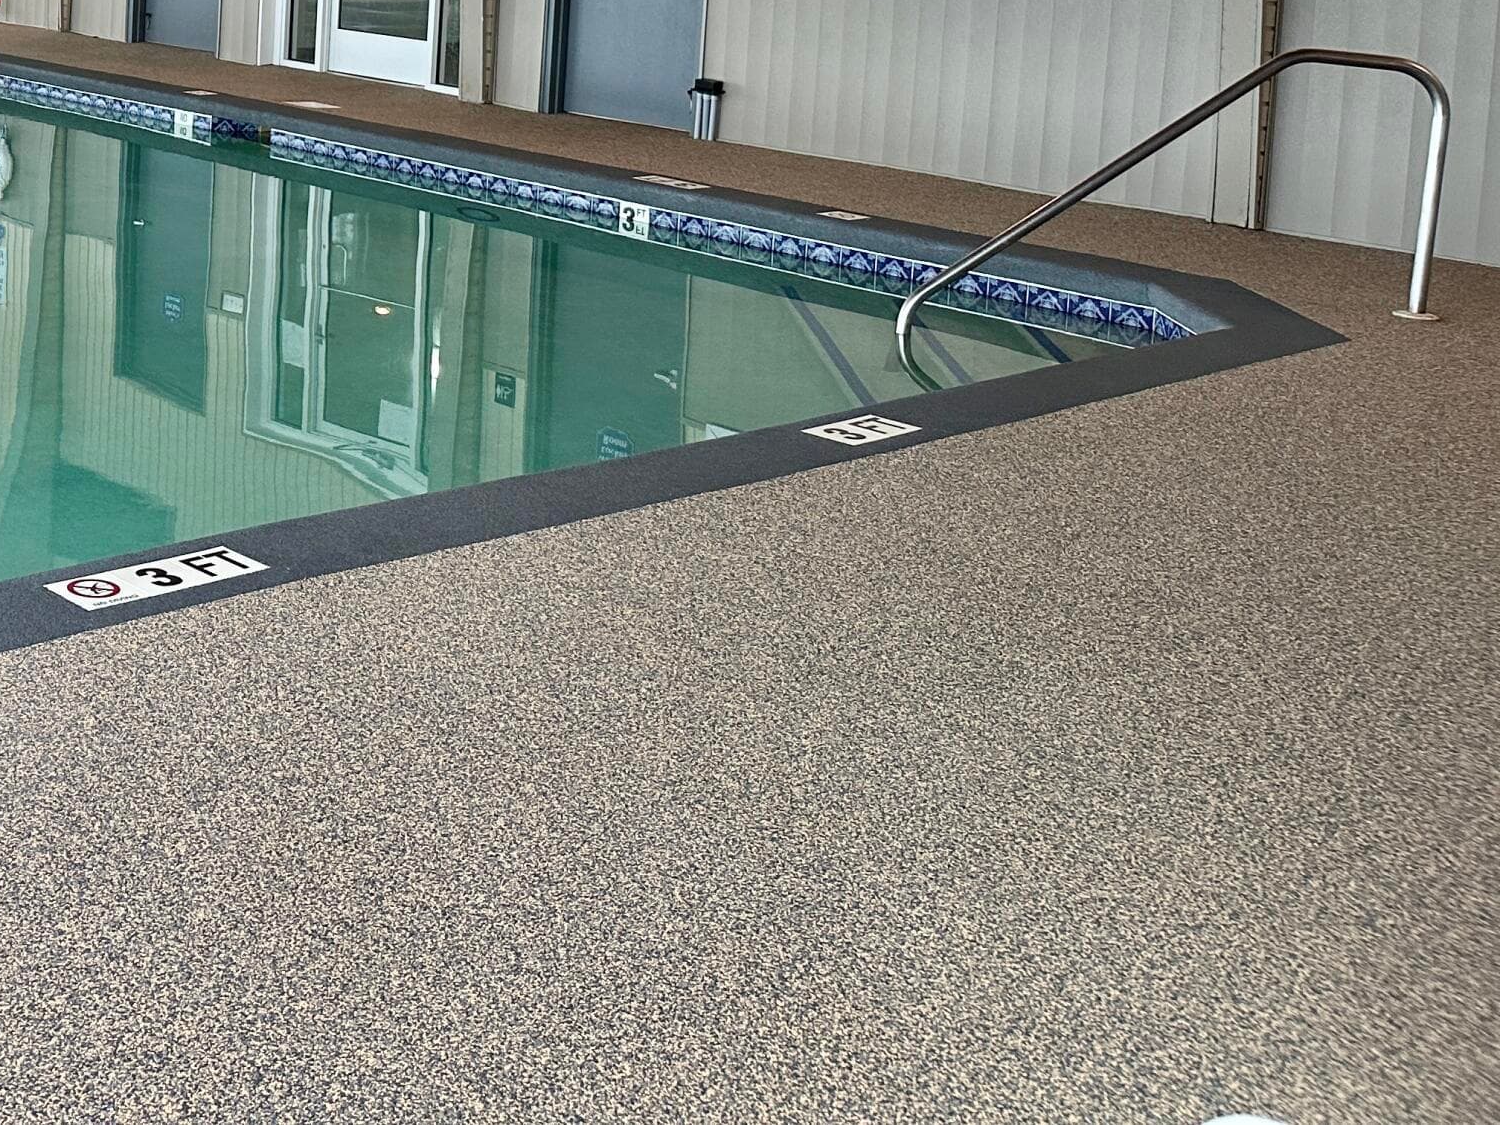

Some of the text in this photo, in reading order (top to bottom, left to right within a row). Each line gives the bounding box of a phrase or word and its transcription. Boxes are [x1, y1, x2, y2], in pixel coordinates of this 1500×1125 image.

[636, 209, 646, 217] FT
[823, 417, 907, 440] 3 FT
[135, 550, 250, 587] 3 FT
